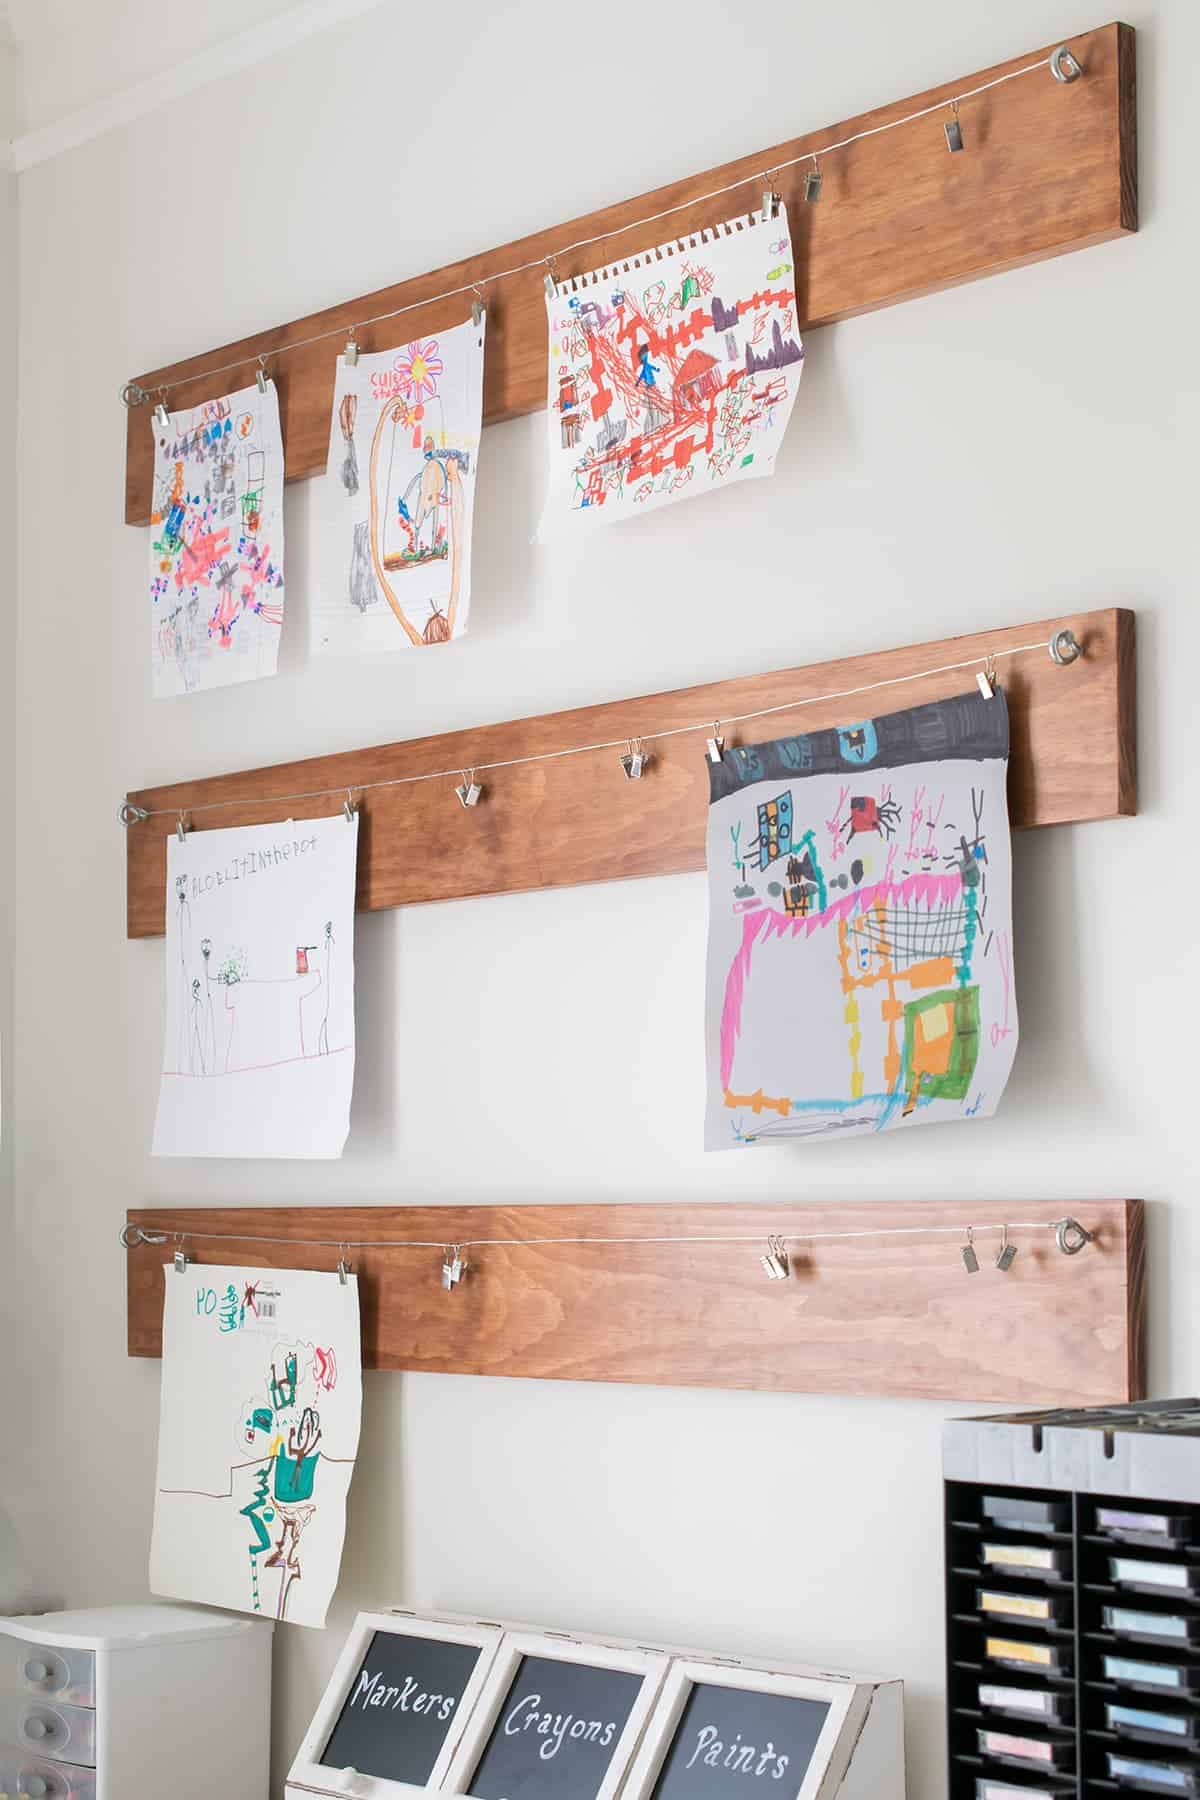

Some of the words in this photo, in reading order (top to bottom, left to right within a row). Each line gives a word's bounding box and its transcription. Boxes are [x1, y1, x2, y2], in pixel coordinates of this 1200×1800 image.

[350, 1670, 455, 1720] Markers
[504, 1694, 617, 1760] Crayons
[685, 1725, 790, 1779] Paints
